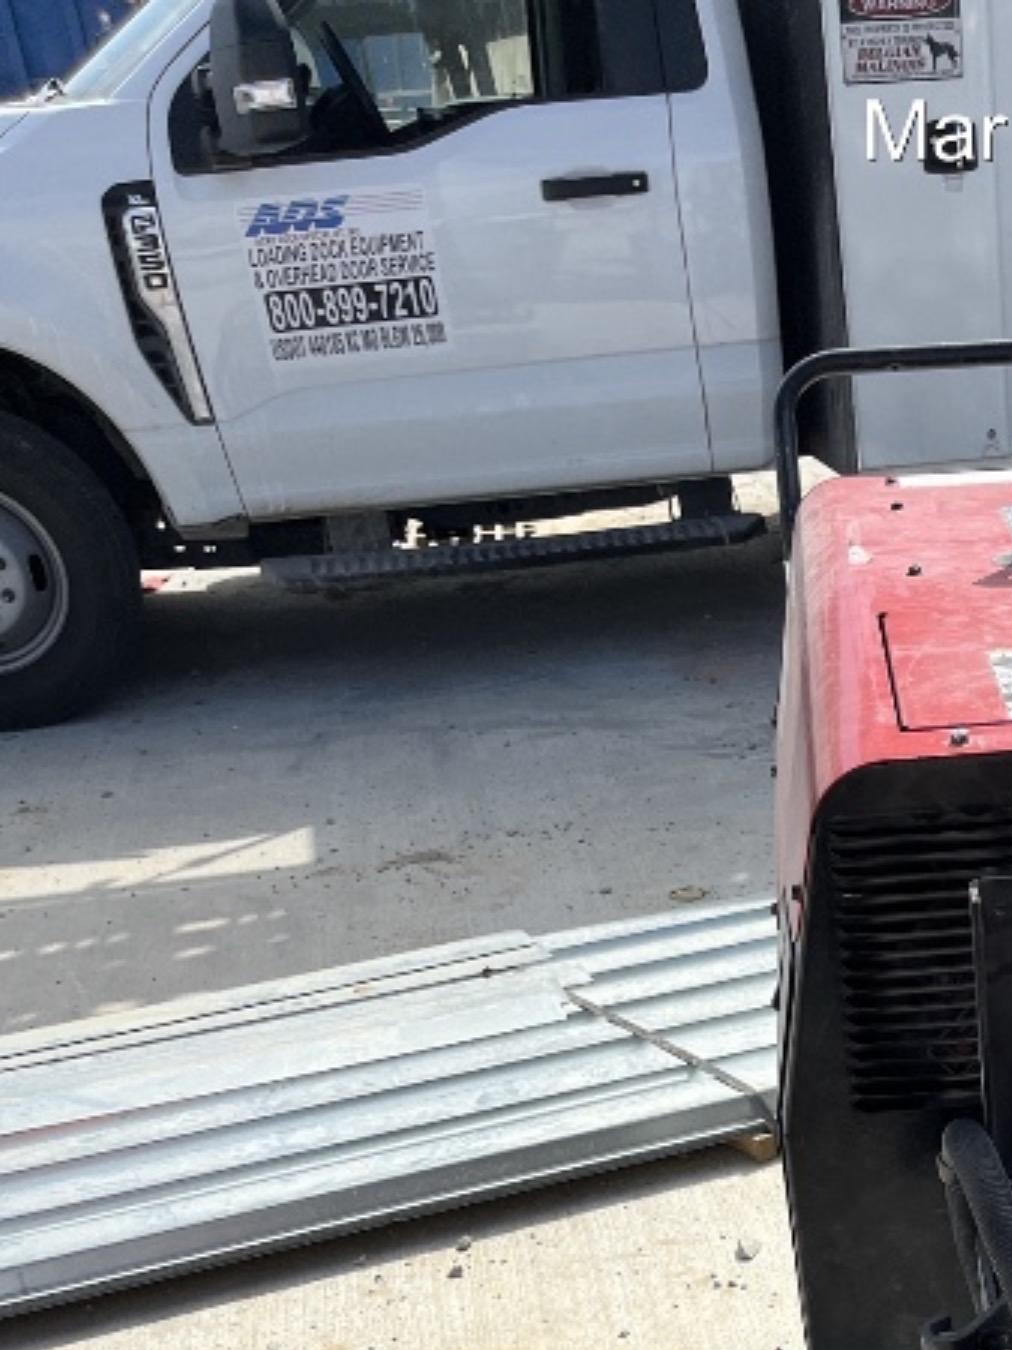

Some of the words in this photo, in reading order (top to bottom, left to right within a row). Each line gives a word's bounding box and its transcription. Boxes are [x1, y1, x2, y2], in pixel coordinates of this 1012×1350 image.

[248, 241, 306, 268] LOADING
[310, 238, 348, 262] DOCK
[350, 230, 424, 256] EQUIPMENT
[266, 263, 337, 288] OVERHEAD
[340, 258, 378, 280] DOOR
[380, 251, 435, 276] SERVICE
[269, 278, 436, 331] 800-899-7210
